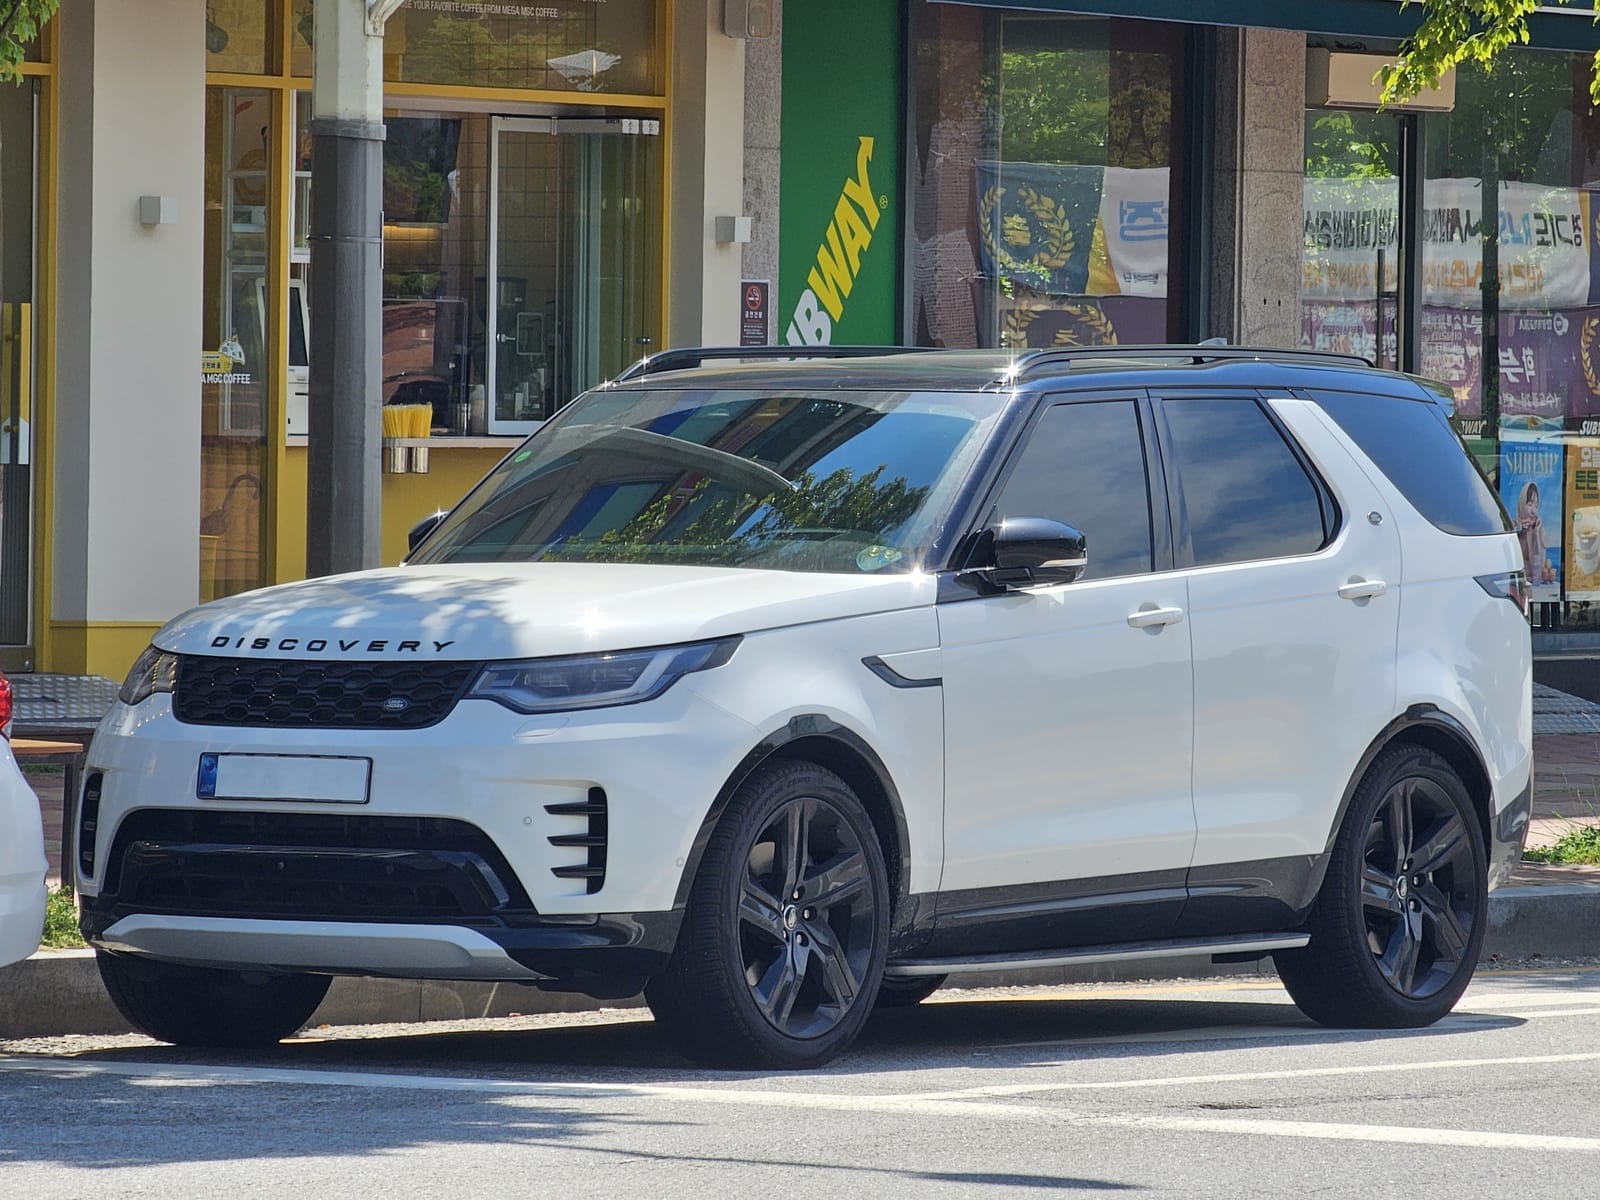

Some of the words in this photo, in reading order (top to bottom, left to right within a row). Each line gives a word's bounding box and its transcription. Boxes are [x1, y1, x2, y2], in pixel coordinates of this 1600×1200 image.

[414, 1, 431, 10] YOUR
[431, 1, 460, 12] FAVORITE
[460, 2, 483, 13] COFFEE
[483, 4, 501, 14] FROM
[501, 5, 520, 16] MEGA
[521, 6, 535, 16] MGC
[536, 7, 559, 18] COFFEE
[207, 374, 223, 384] MGC
[223, 373, 251, 384] COFFEE
[1580, 420, 1600, 435] SUB
[211, 636, 455, 652] DISCOVERY
